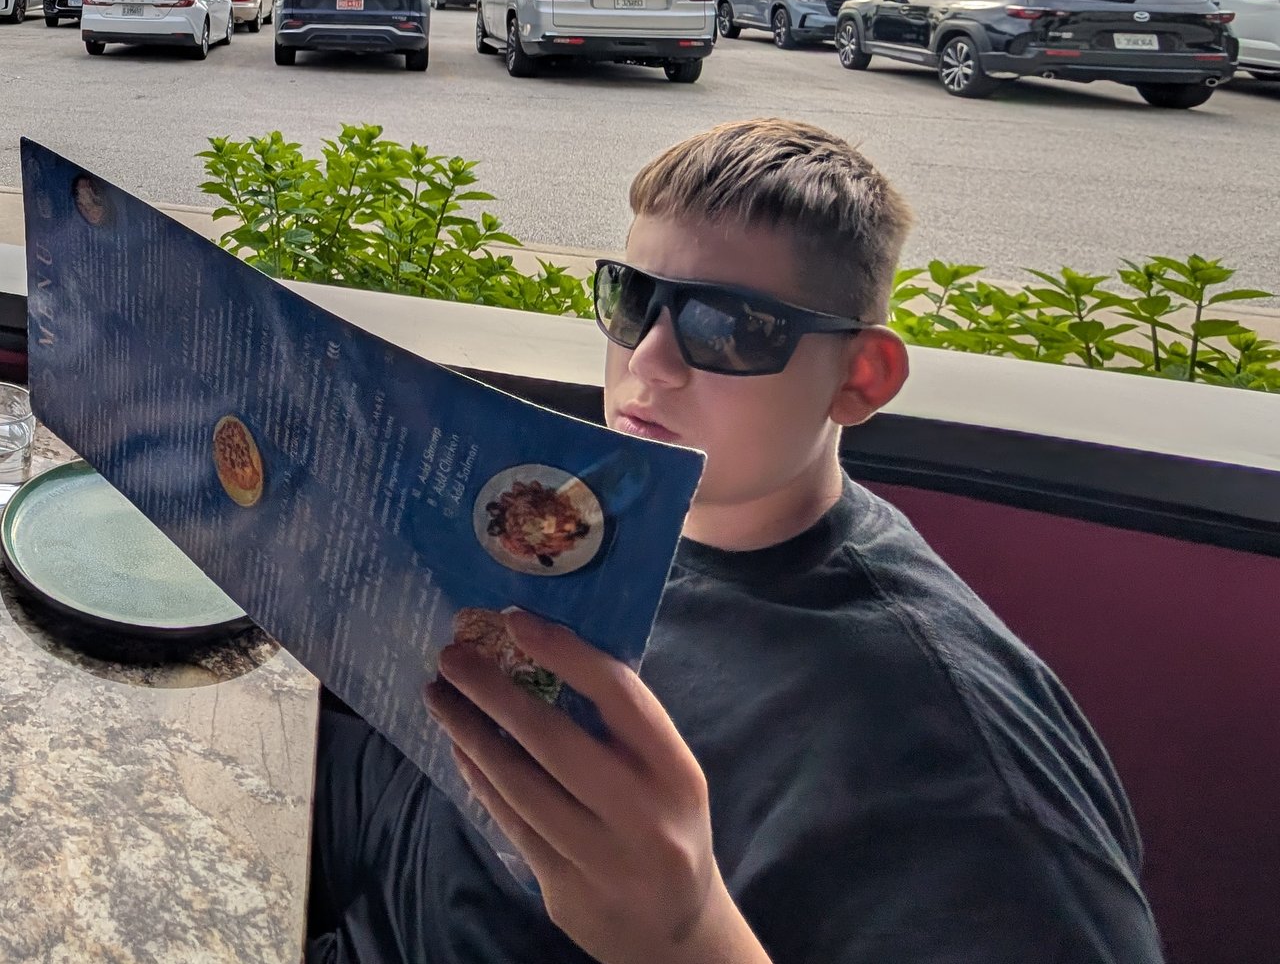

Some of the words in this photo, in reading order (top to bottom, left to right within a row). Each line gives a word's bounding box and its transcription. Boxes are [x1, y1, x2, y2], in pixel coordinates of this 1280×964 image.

[424, 427, 442, 463] Shrimp
[439, 434, 460, 473] Chicken
[418, 459, 431, 485] Add
[456, 444, 479, 482] Salmon
[433, 468, 447, 497] Add
[450, 479, 465, 505] Add
